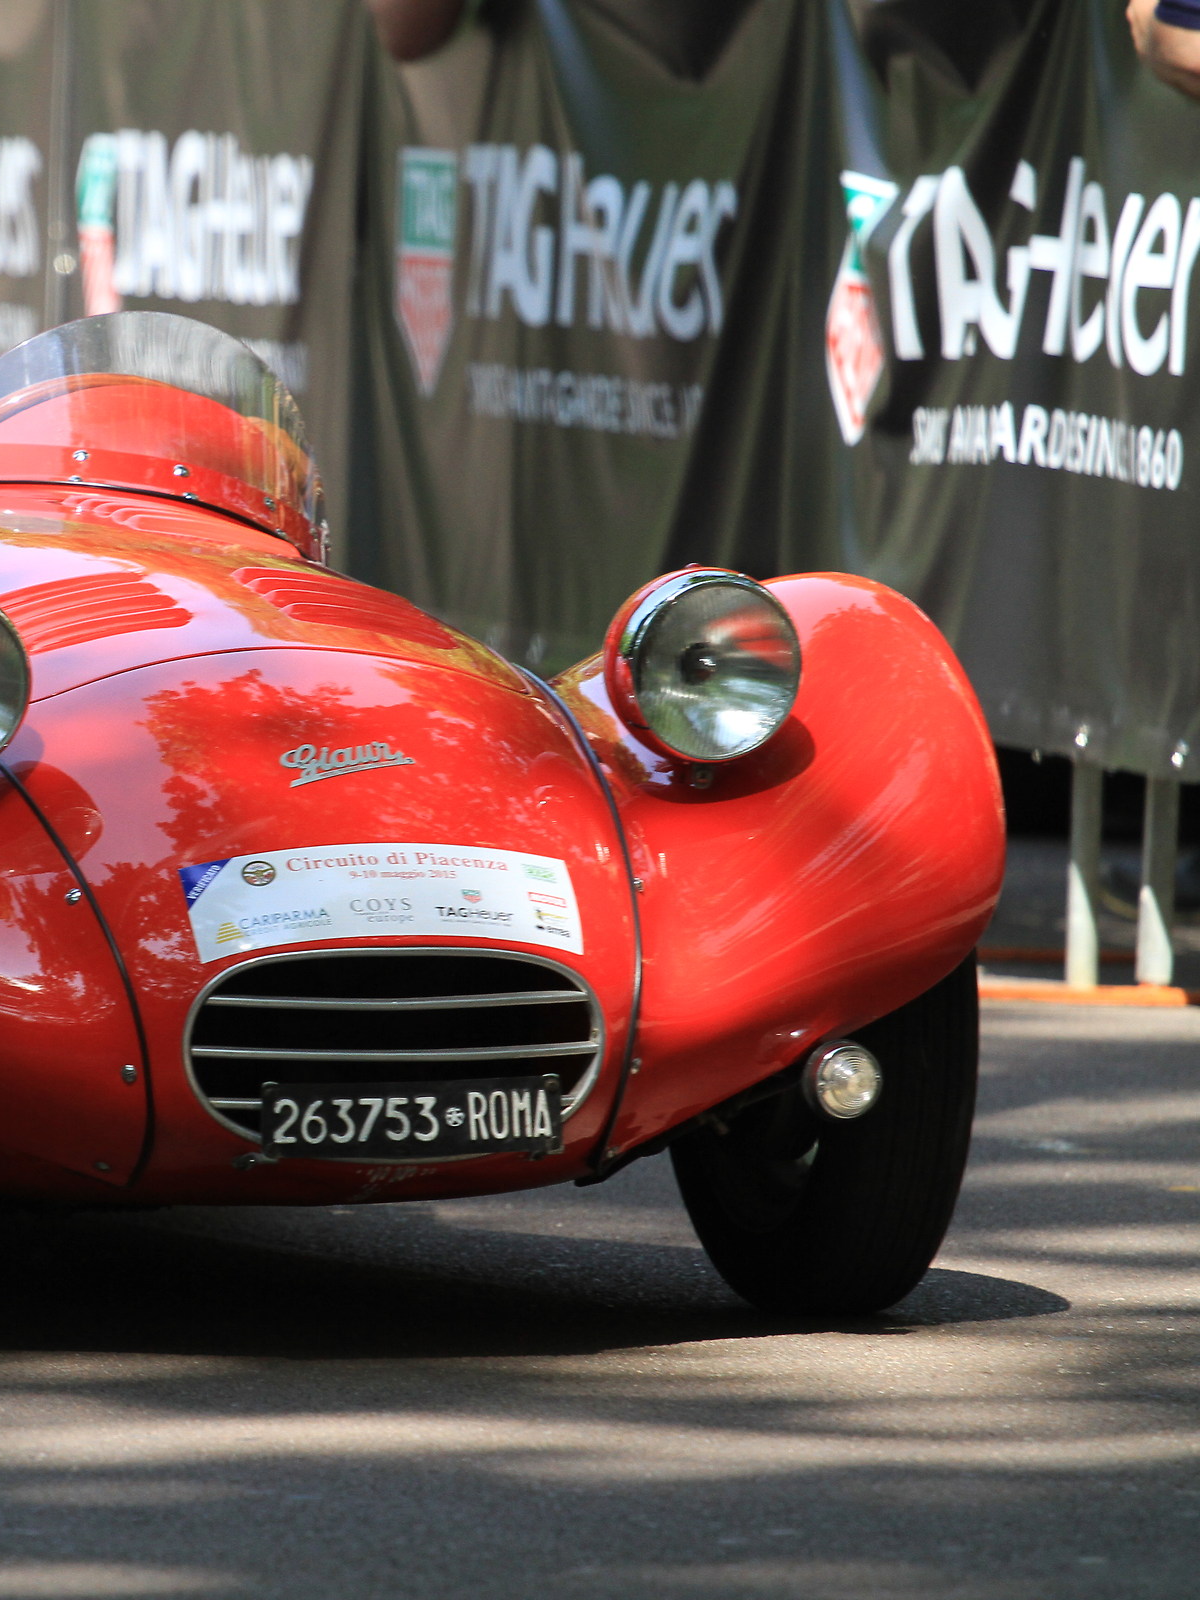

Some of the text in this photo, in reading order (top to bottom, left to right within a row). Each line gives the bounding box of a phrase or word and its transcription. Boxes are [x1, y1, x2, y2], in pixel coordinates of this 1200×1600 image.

[280, 741, 415, 788] Giaur
[286, 851, 509, 872] Circuito di Piacenza
[187, 864, 221, 901] VERIFICATO
[381, 870, 426, 880] maggio
[429, 870, 457, 879] 2015
[350, 898, 412, 912] COYS
[238, 907, 330, 930] CARIPARMA
[367, 914, 414, 924] europe
[273, 1088, 551, 1144] 263753 ROMA
